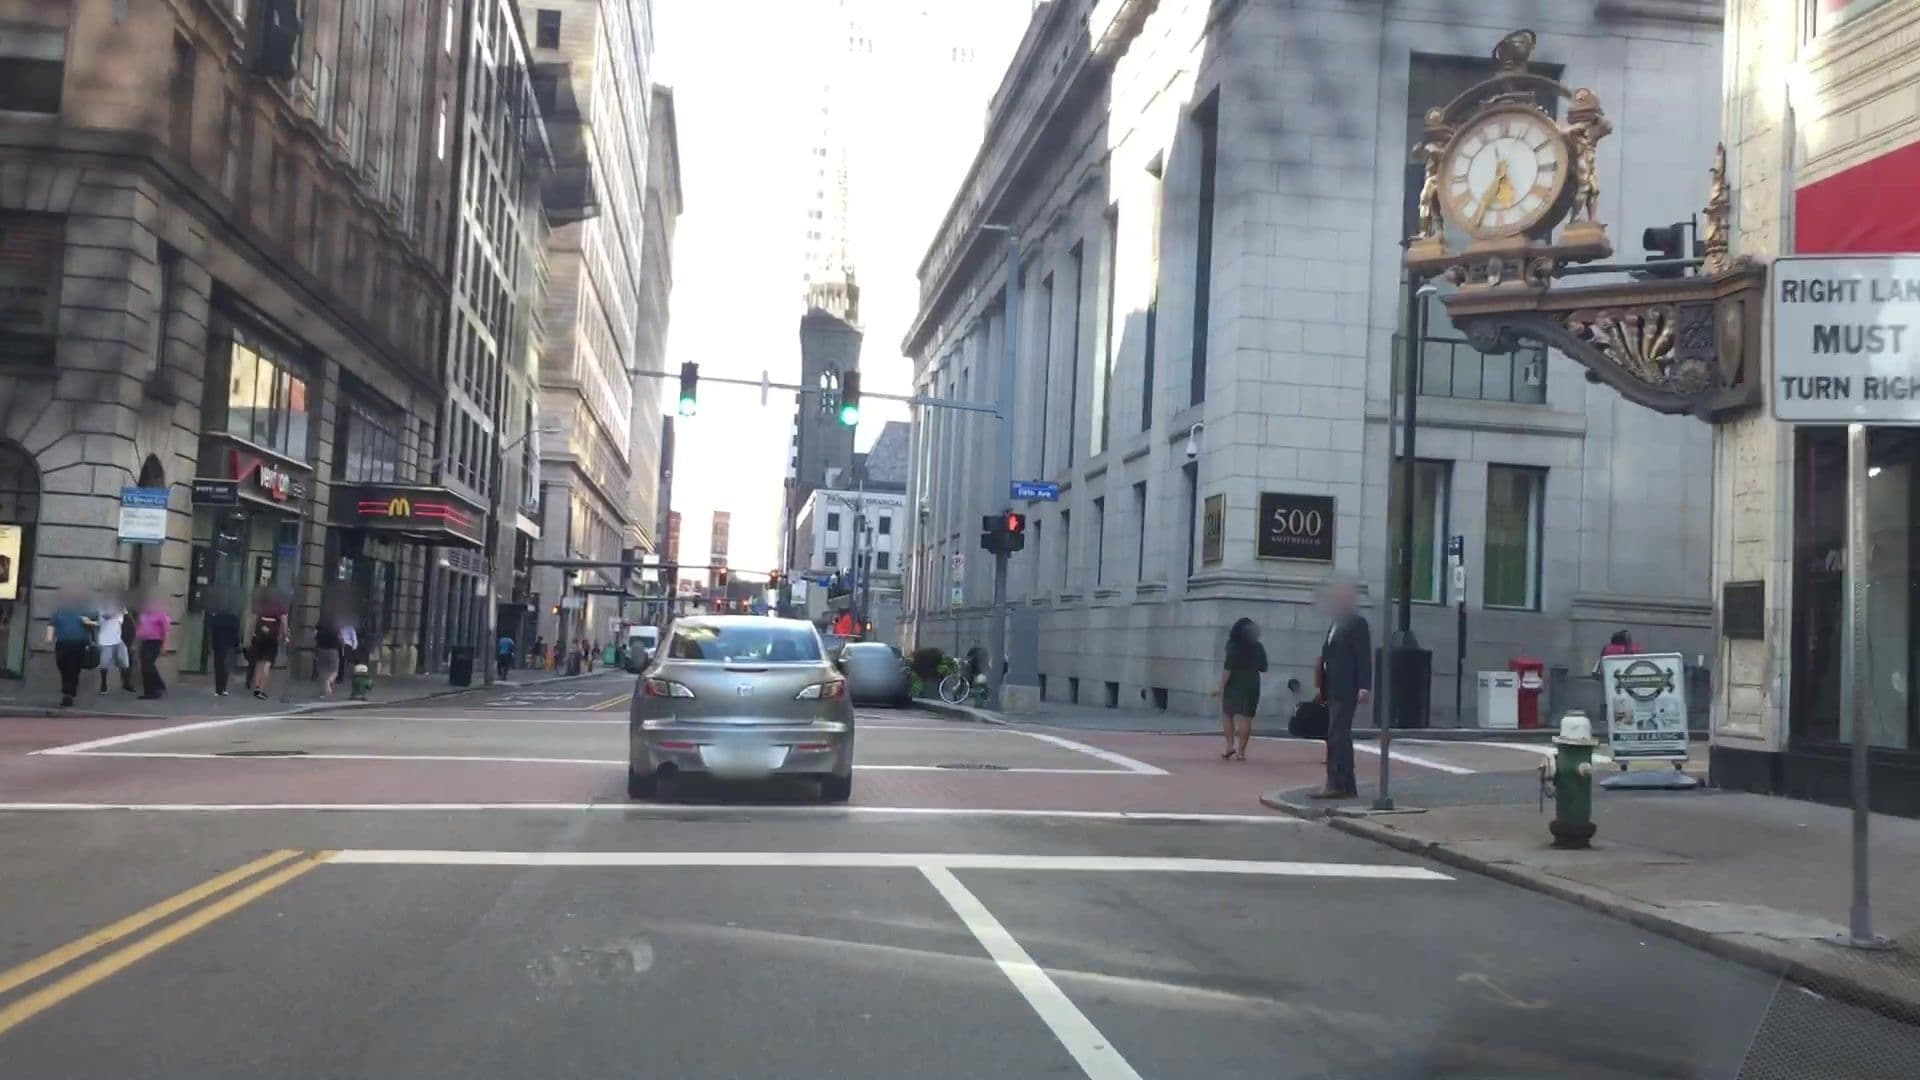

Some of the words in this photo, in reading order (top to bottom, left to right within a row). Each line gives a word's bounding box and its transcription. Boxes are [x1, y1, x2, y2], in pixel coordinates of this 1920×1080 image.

[1782, 279, 1861, 303] RIGHT
[1812, 324, 1908, 355] MUST
[1781, 375, 1850, 400] TURN
[1018, 487, 1035, 497] Fifth
[1037, 489, 1052, 498] Ave
[1271, 509, 1321, 536] 500
